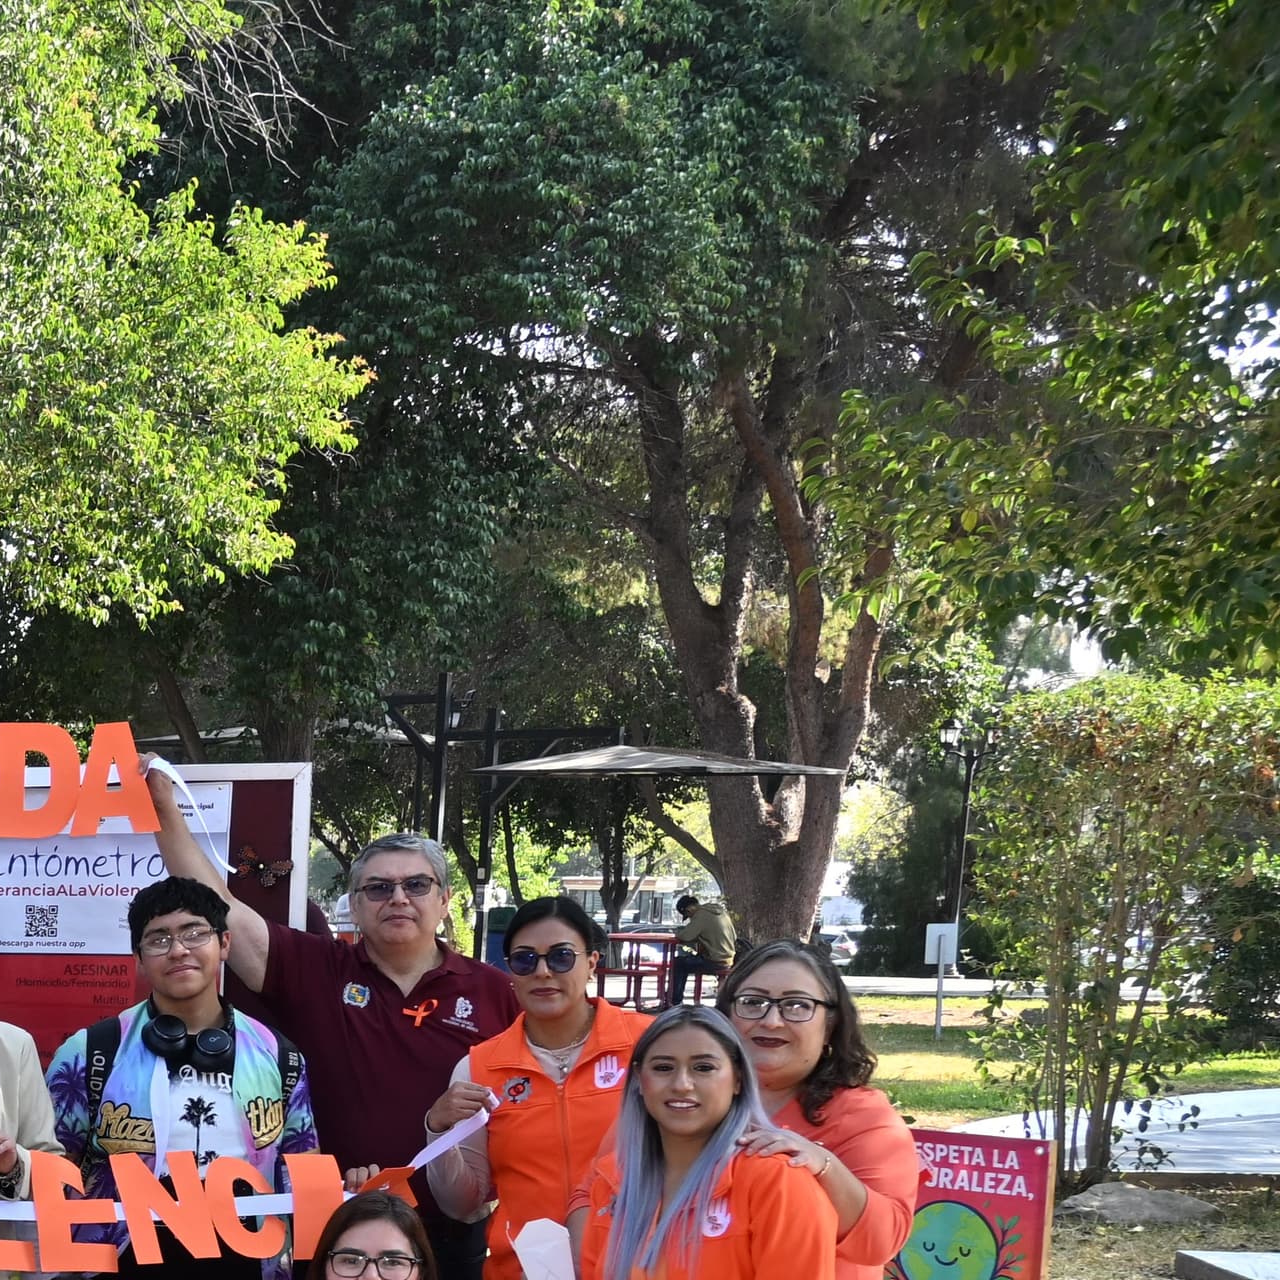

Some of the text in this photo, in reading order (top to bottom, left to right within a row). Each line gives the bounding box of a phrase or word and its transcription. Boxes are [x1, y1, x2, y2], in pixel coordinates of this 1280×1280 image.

[68, 941, 86, 949] app
[63, 964, 128, 977] ASESINAR
[992, 1149, 1020, 1171] LA
